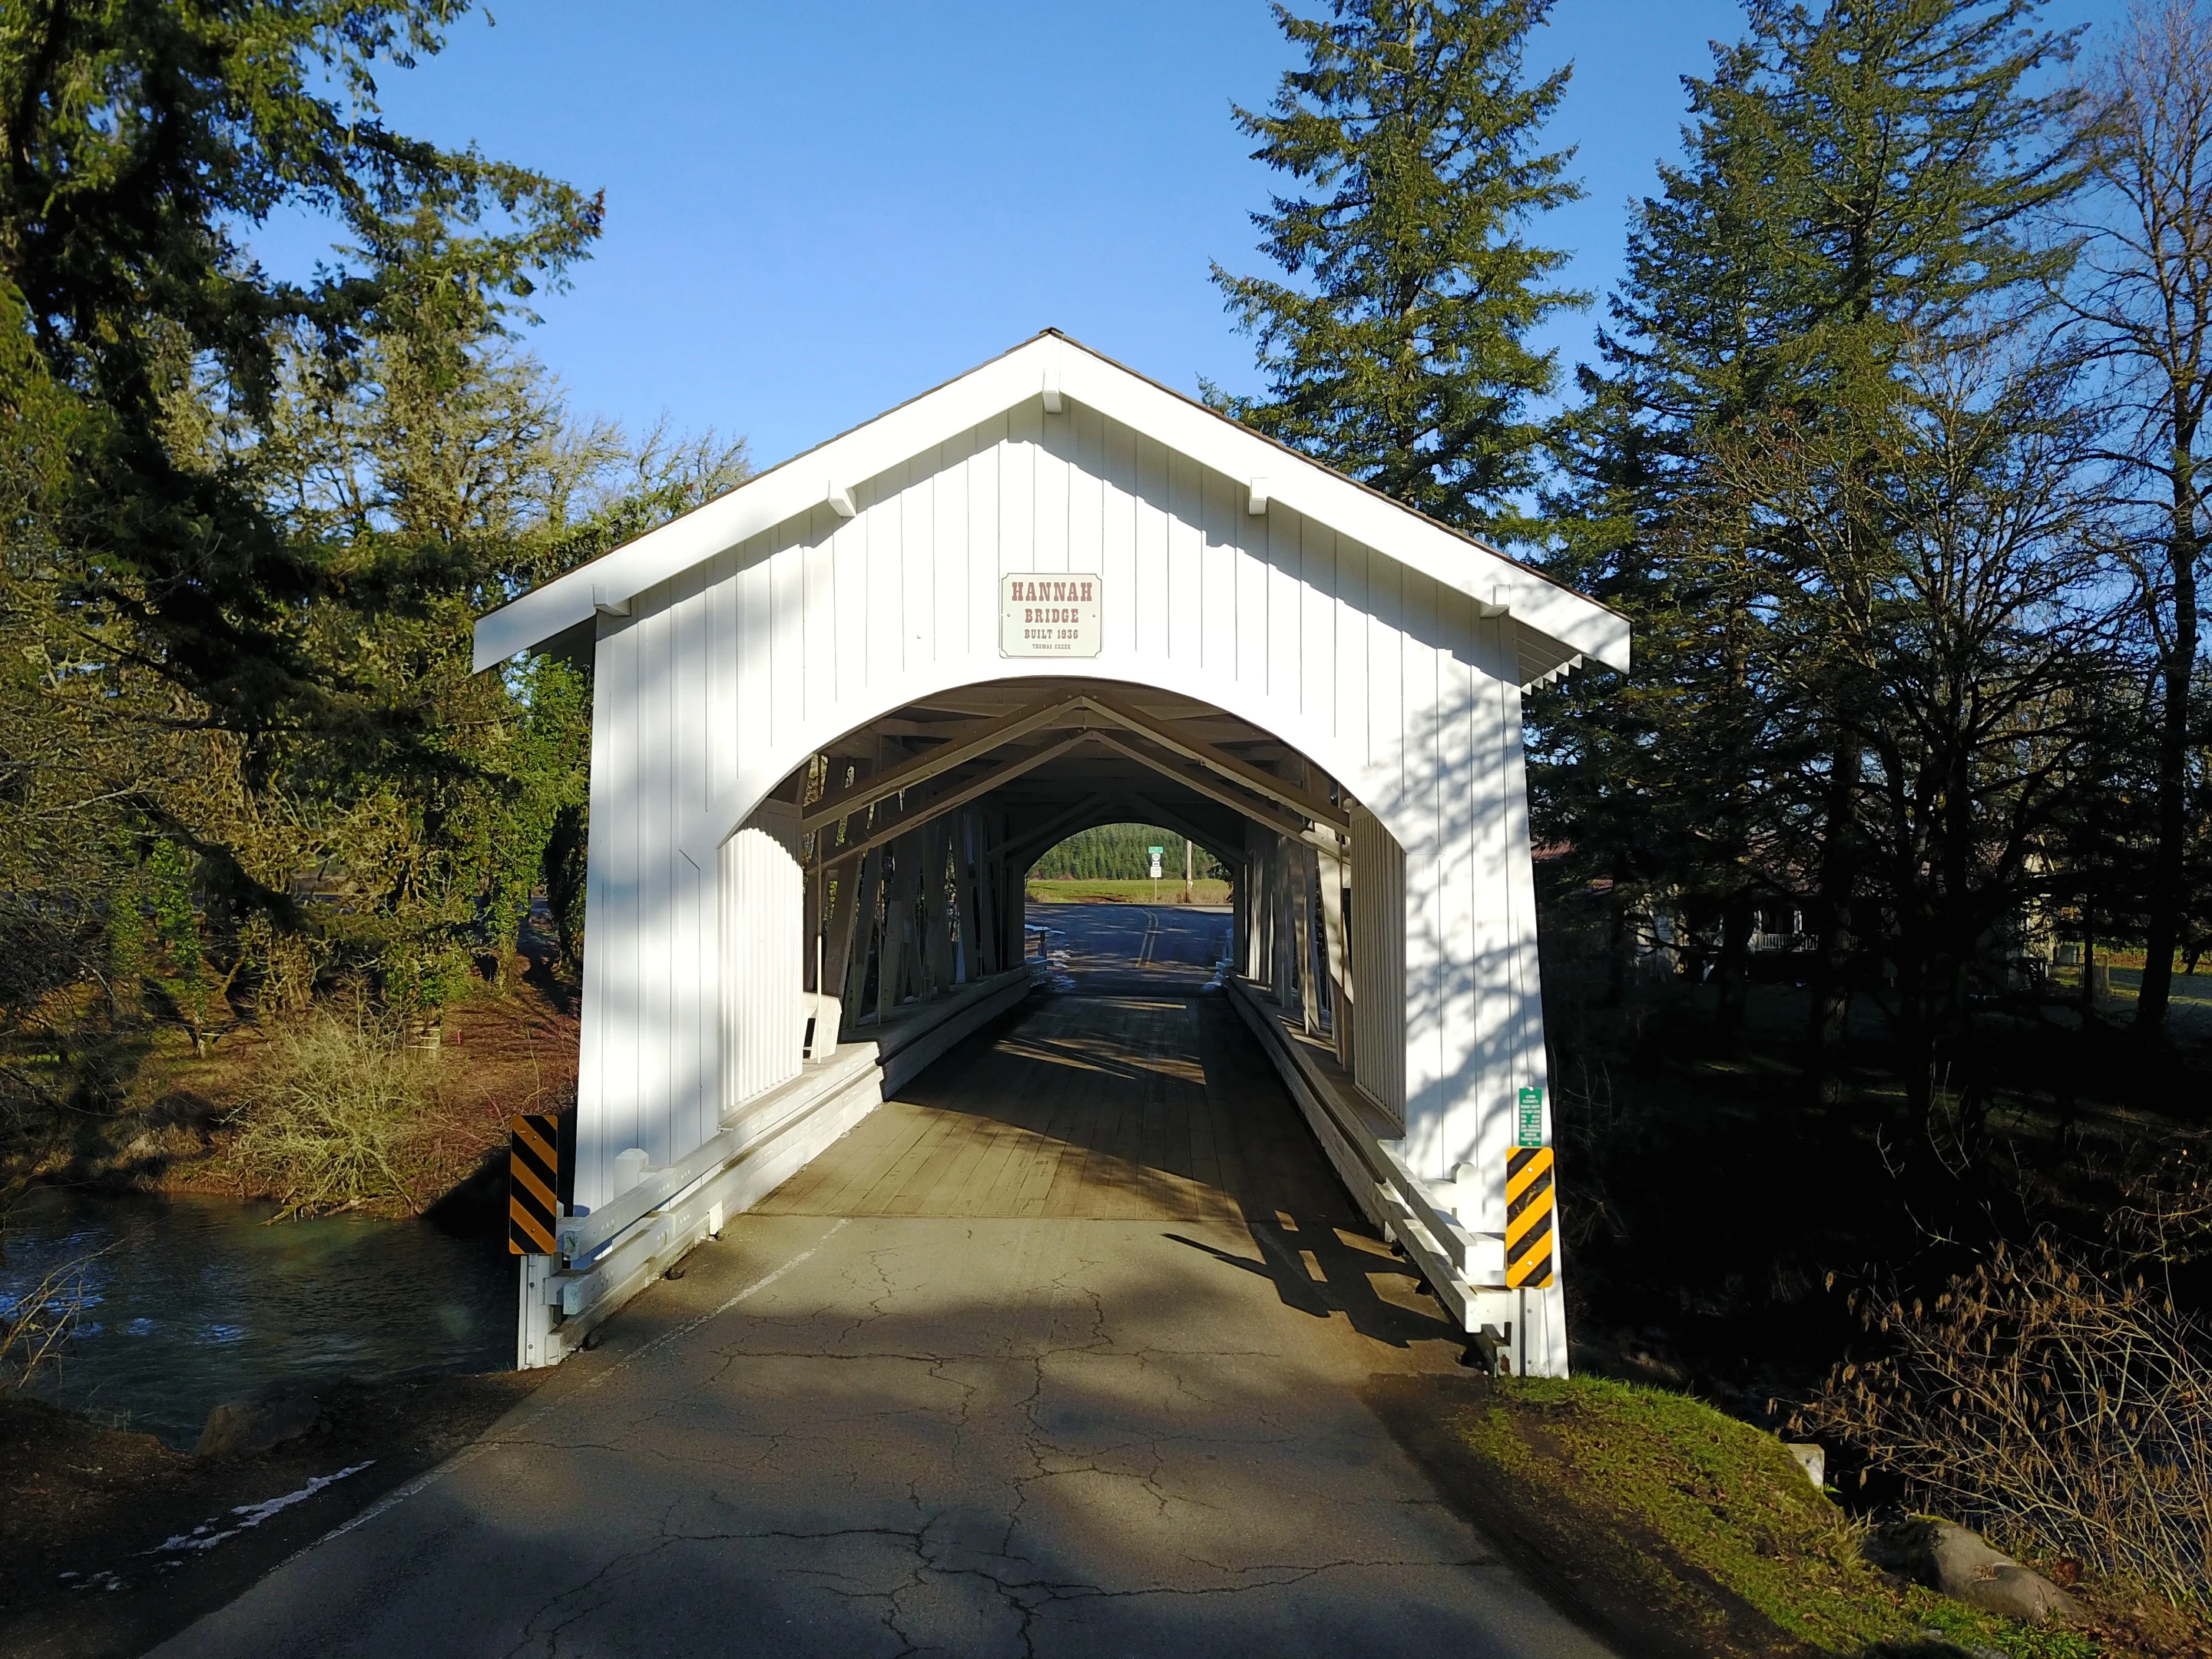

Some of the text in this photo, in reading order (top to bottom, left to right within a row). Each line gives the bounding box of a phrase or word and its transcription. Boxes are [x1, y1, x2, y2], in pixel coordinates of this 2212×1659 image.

[1012, 581, 1092, 602] HANNAH
[1025, 608, 1079, 624] BRIDGE
[1024, 628, 1078, 639] BUILT 1936
